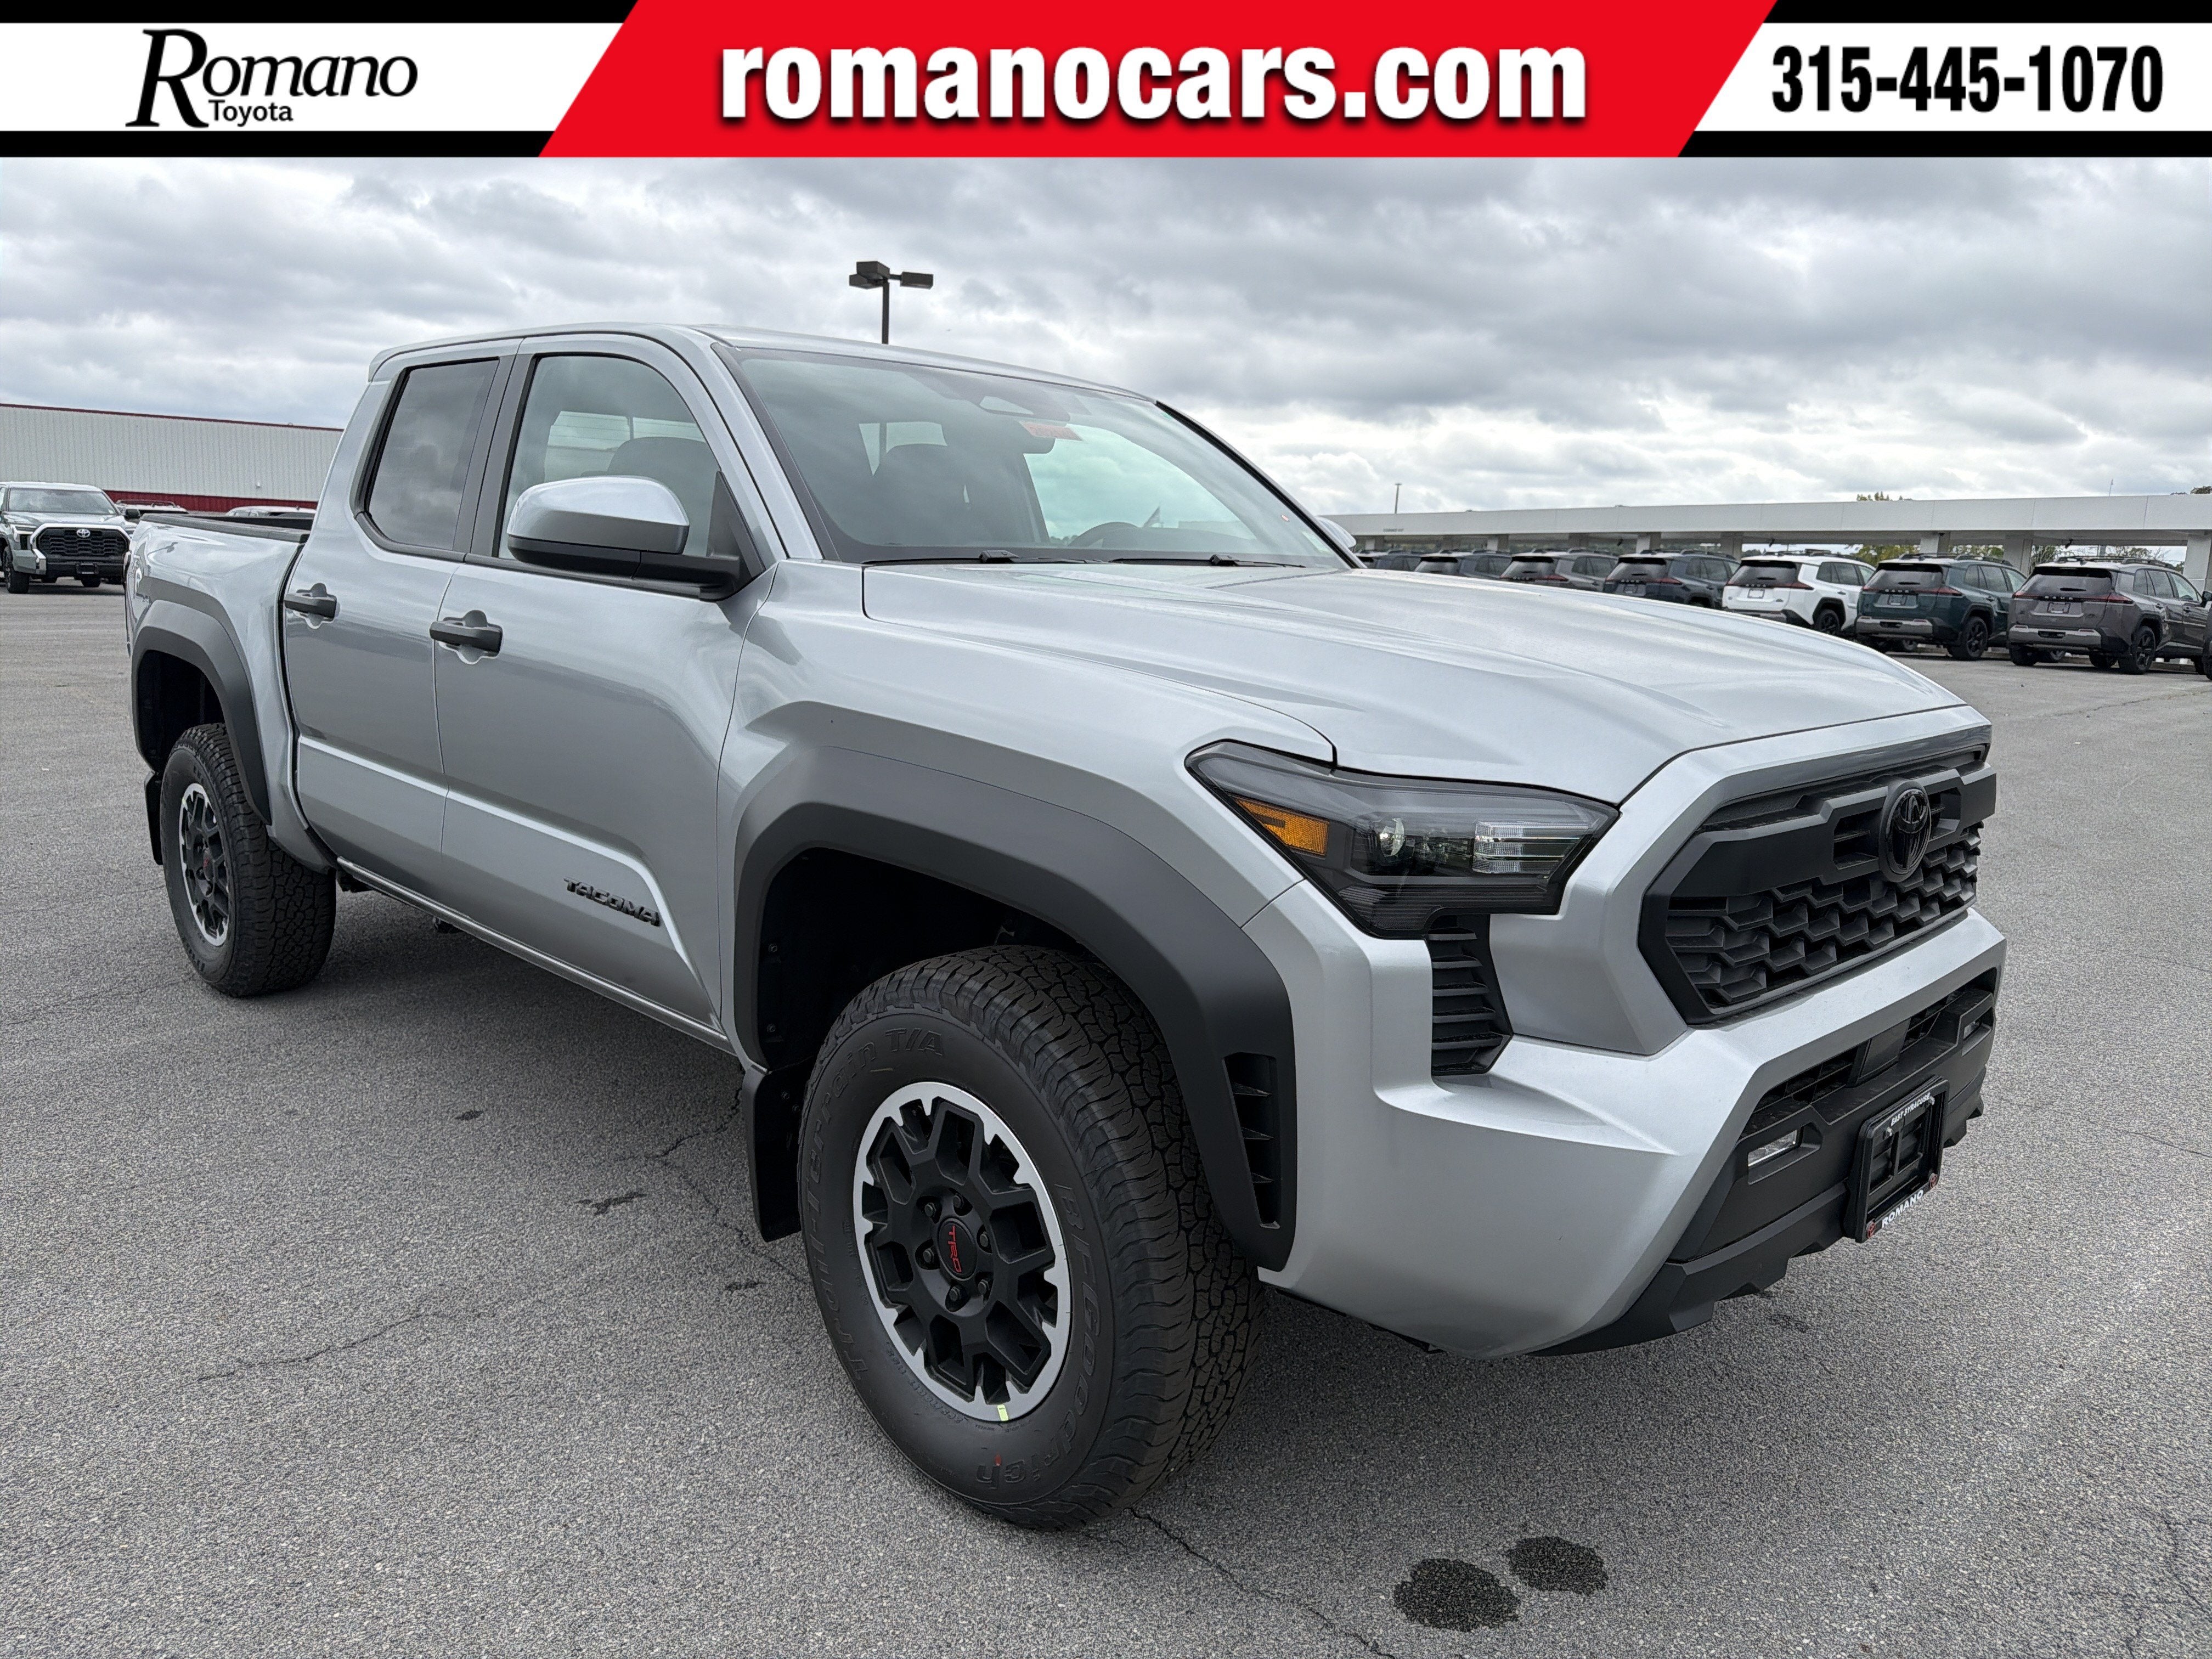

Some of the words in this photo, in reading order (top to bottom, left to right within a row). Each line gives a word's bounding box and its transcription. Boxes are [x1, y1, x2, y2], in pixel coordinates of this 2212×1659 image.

[563, 877, 661, 927] TACOMA
[885, 1027, 945, 1057] T/A
[1891, 1110, 1904, 1127] EAST
[1904, 1092, 1931, 1116] SYRACUSE
[1881, 1189, 1923, 1229] ROMANO
[947, 1224, 962, 1273] TRD
